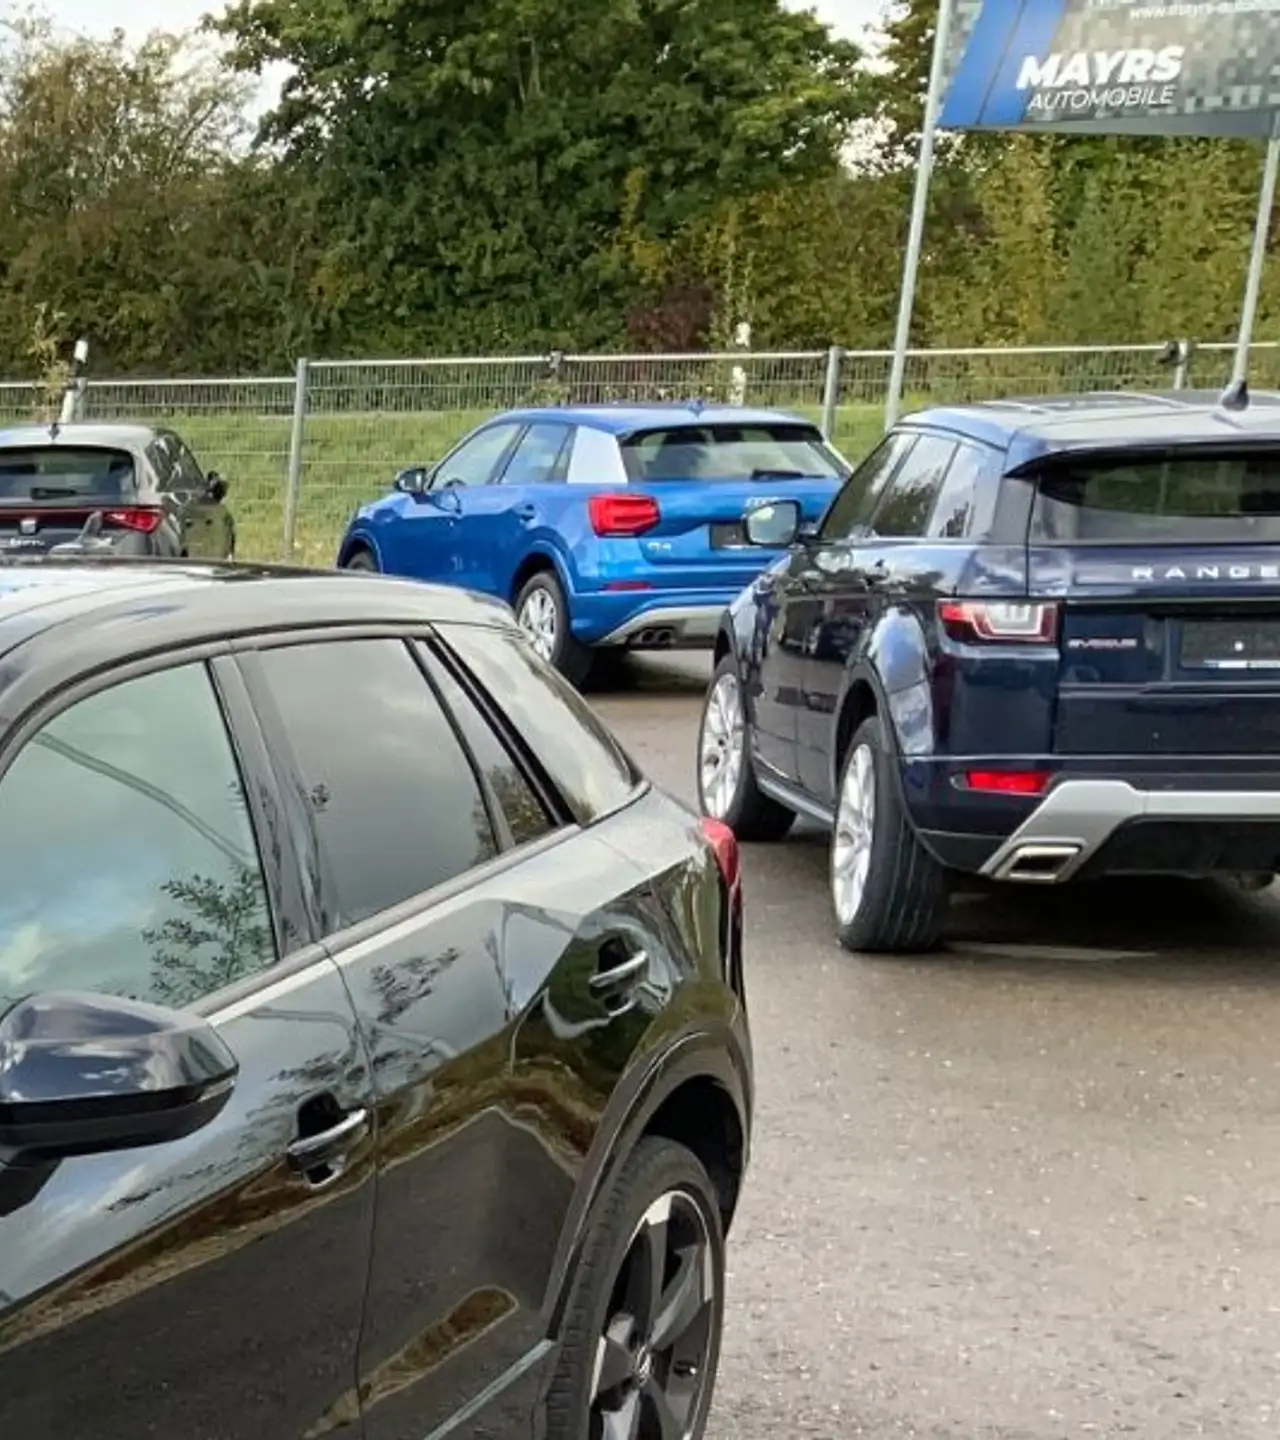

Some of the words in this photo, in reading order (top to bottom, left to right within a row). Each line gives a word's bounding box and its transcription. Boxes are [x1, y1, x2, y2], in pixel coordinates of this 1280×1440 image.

[1015, 45, 1186, 90] MAYRS
[1027, 84, 1179, 112] AUTOMOBILE
[1131, 565, 1279, 580] RANGE
